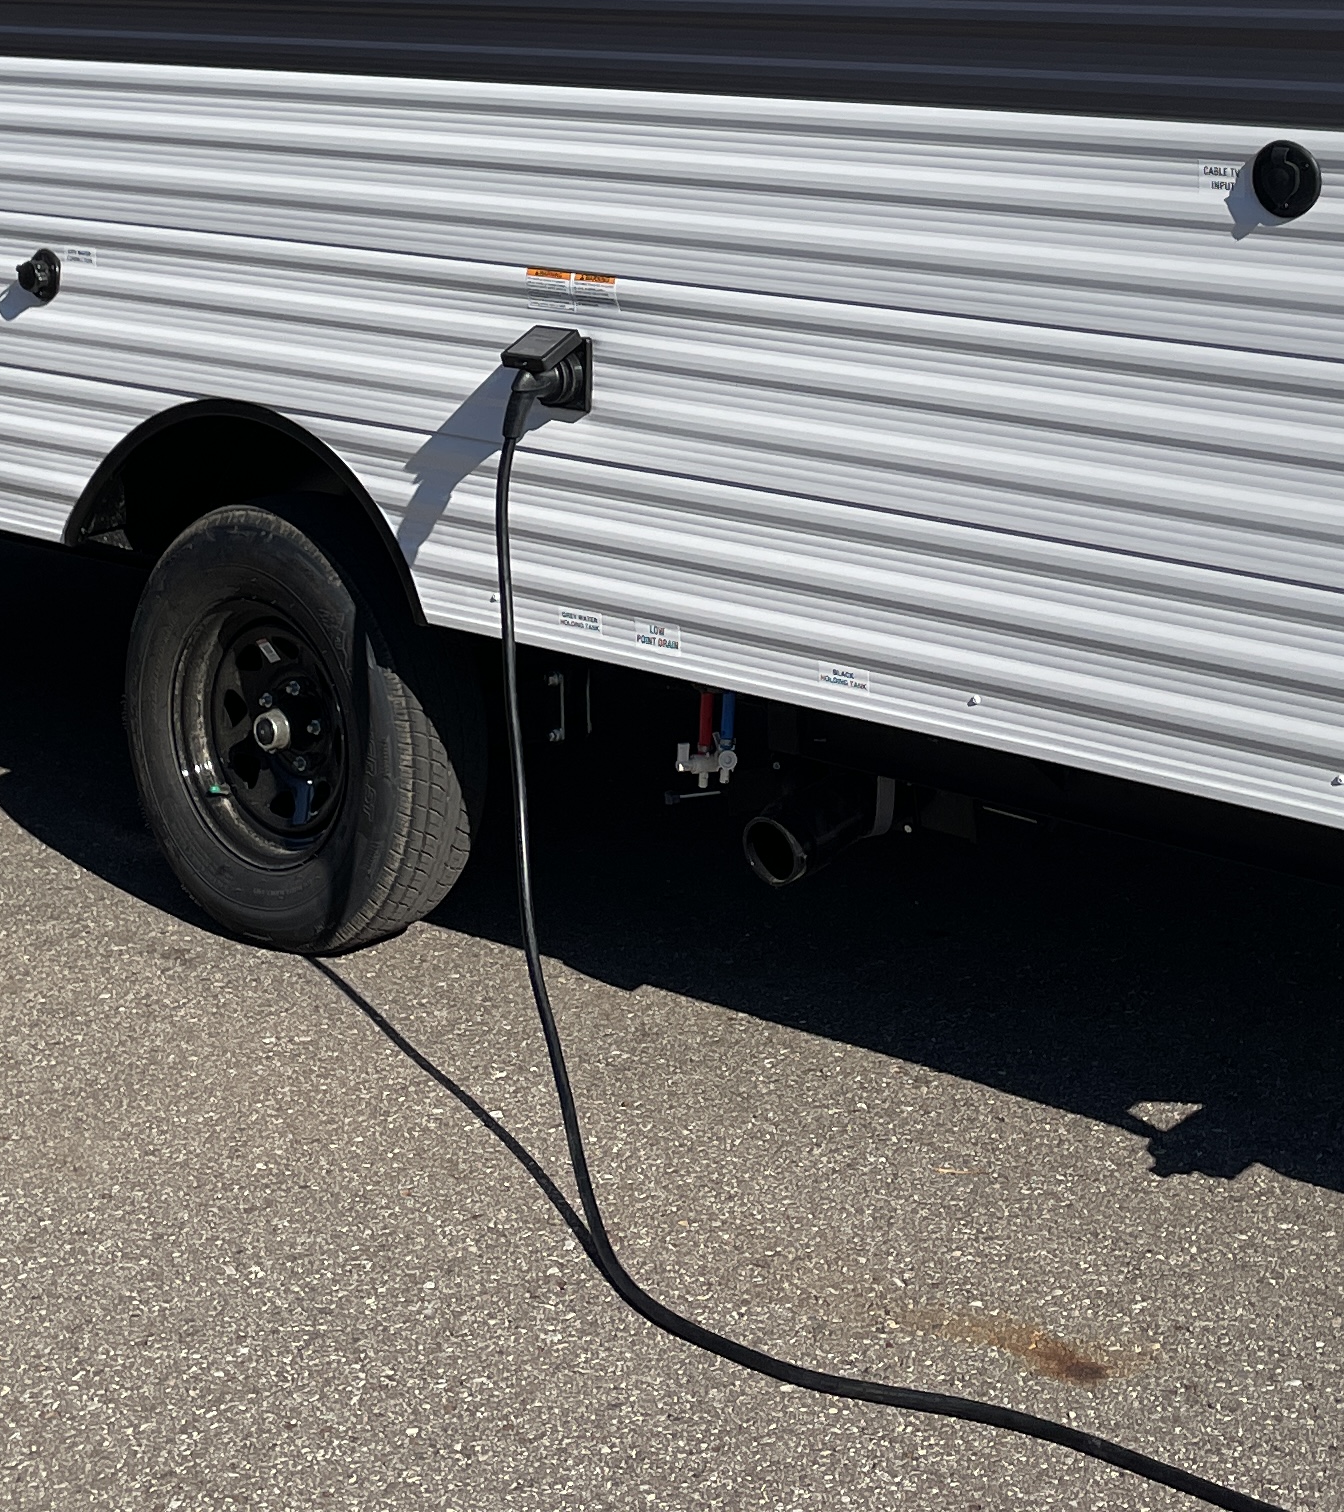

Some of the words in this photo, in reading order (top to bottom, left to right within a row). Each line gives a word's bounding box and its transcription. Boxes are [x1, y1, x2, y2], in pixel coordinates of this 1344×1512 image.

[1203, 165, 1229, 177] CABLE
[1231, 168, 1240, 178] TV
[1211, 180, 1236, 192] INPUT
[649, 624, 666, 637] LOW
[636, 634, 657, 646] POINT
[657, 637, 679, 650] DRAIN
